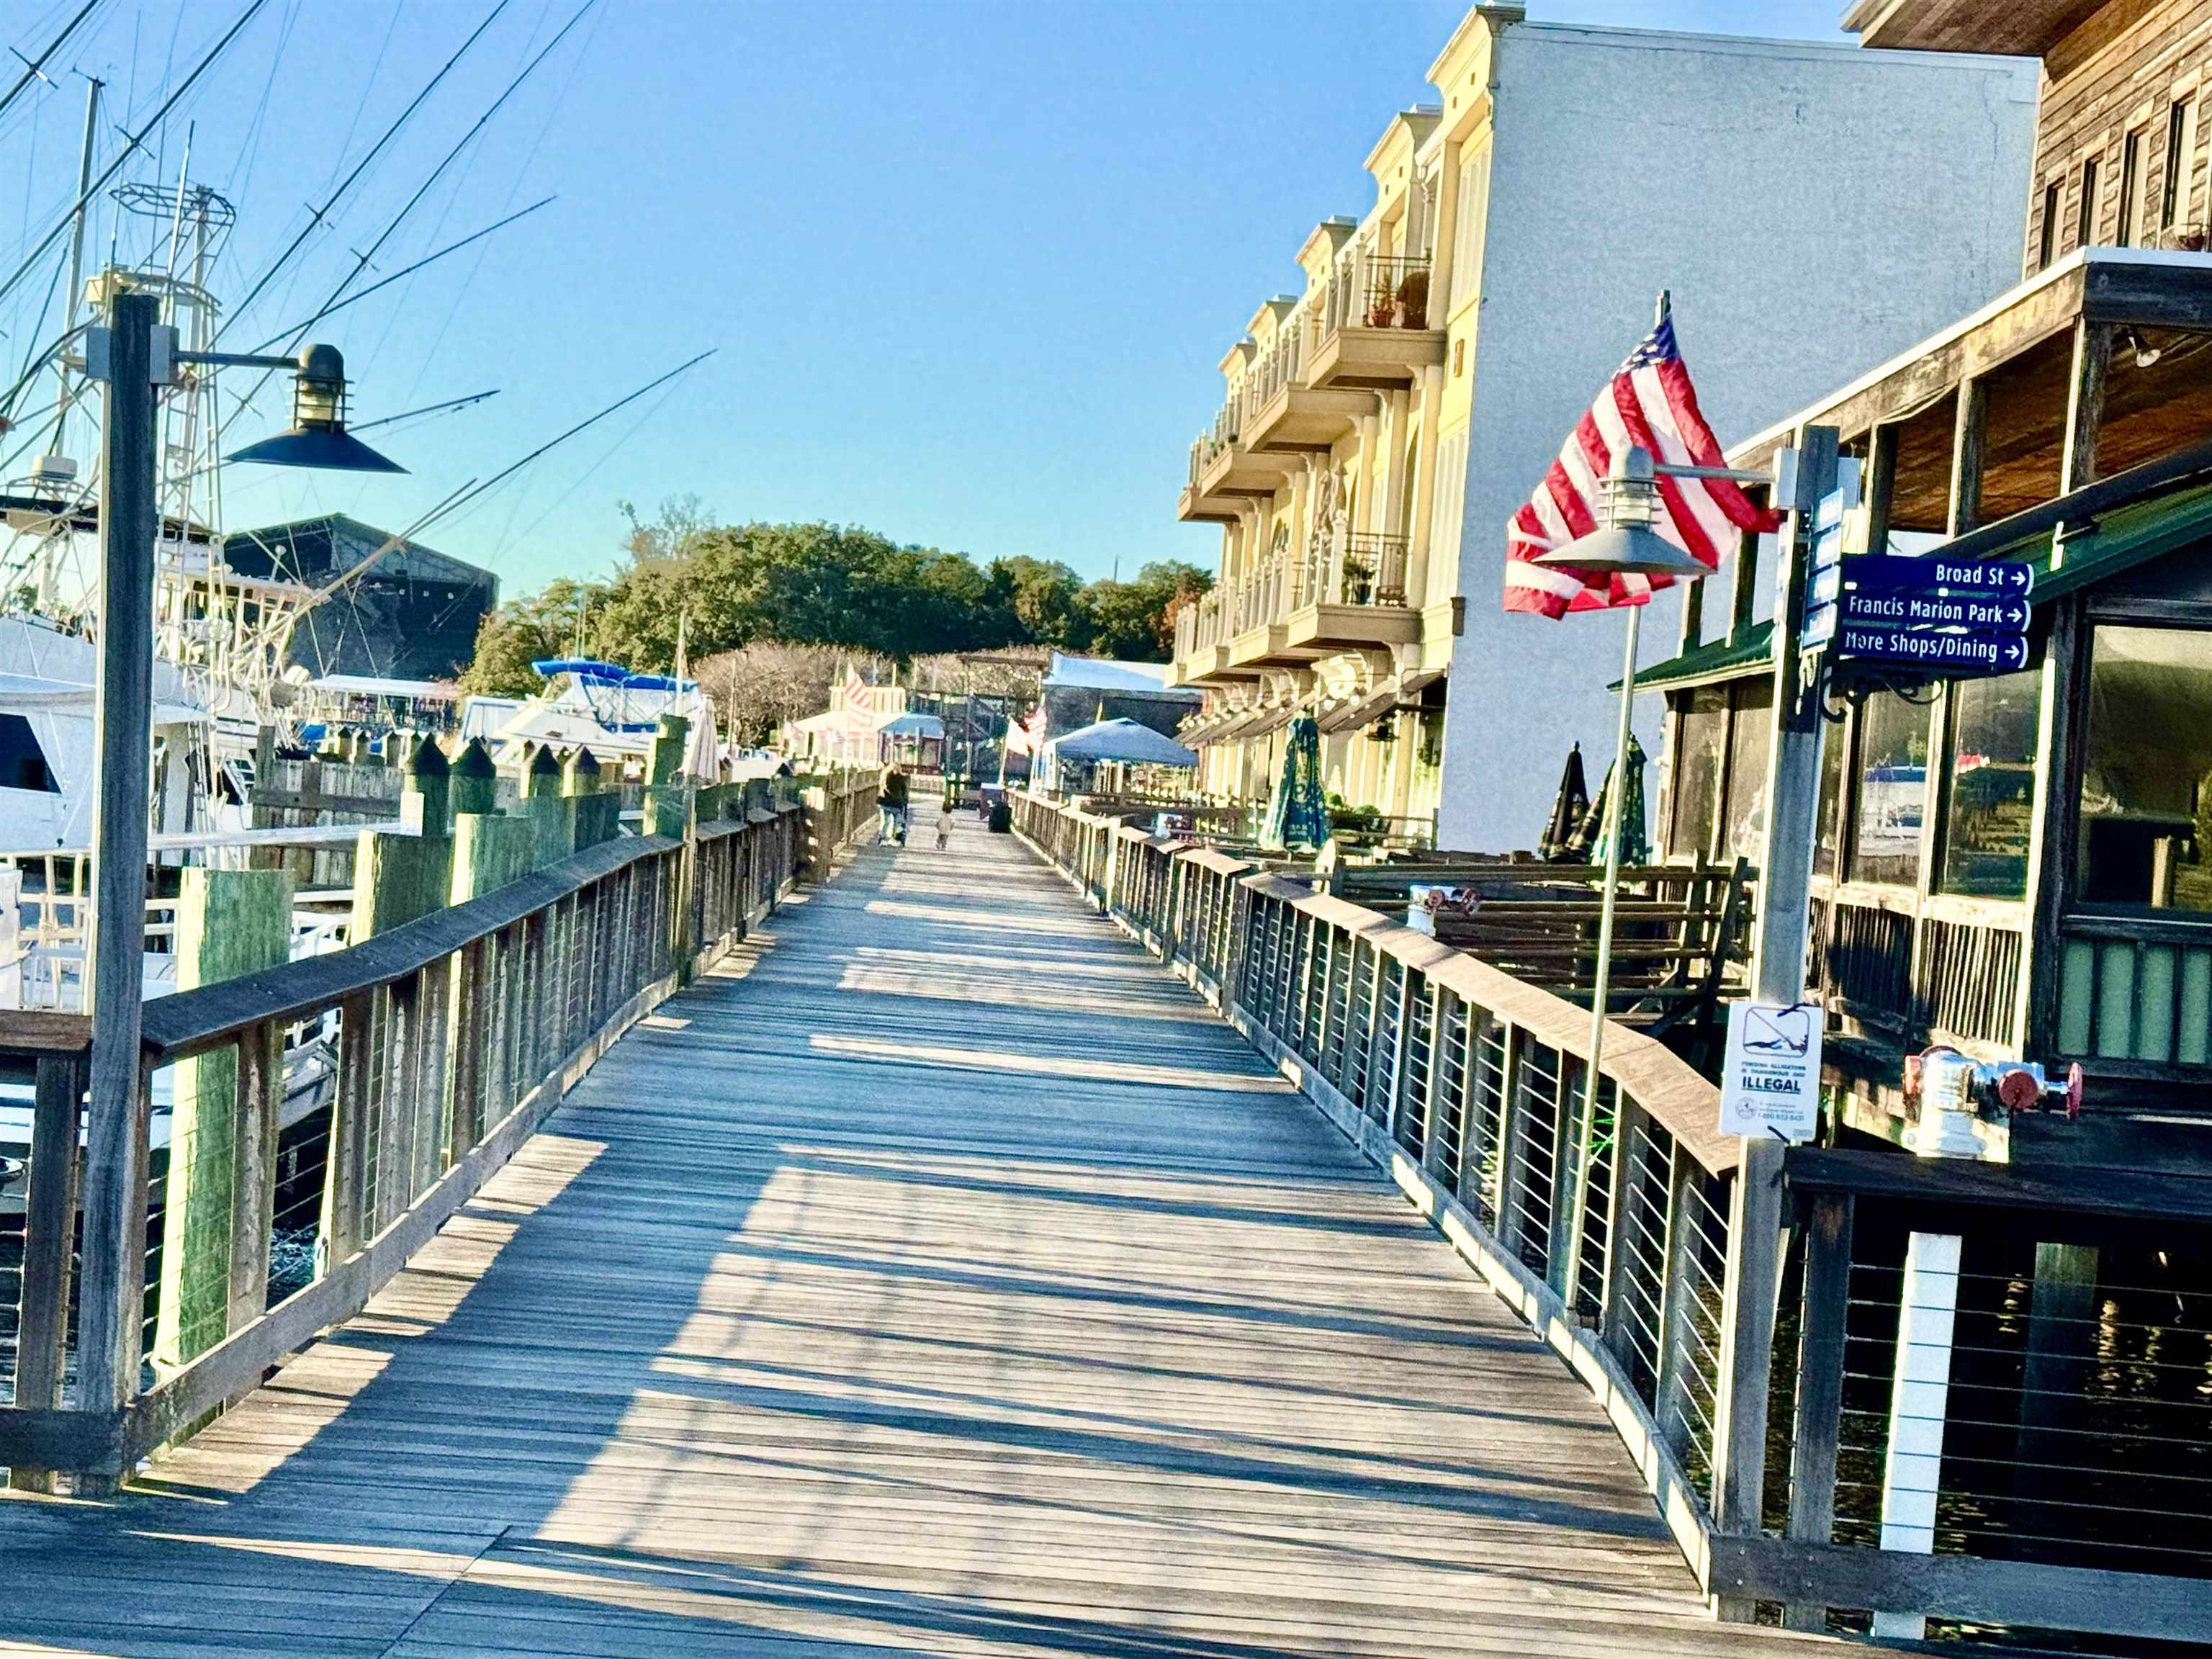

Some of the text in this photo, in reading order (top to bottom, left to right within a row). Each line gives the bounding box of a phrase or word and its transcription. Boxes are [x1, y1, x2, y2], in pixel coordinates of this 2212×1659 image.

[1936, 564, 2005, 585] Broad St
[1849, 595, 2003, 624] Francis Marion Park
[1845, 632, 1998, 663] More Shops/Dining
[1743, 1076, 1801, 1092] ILLEGAL
